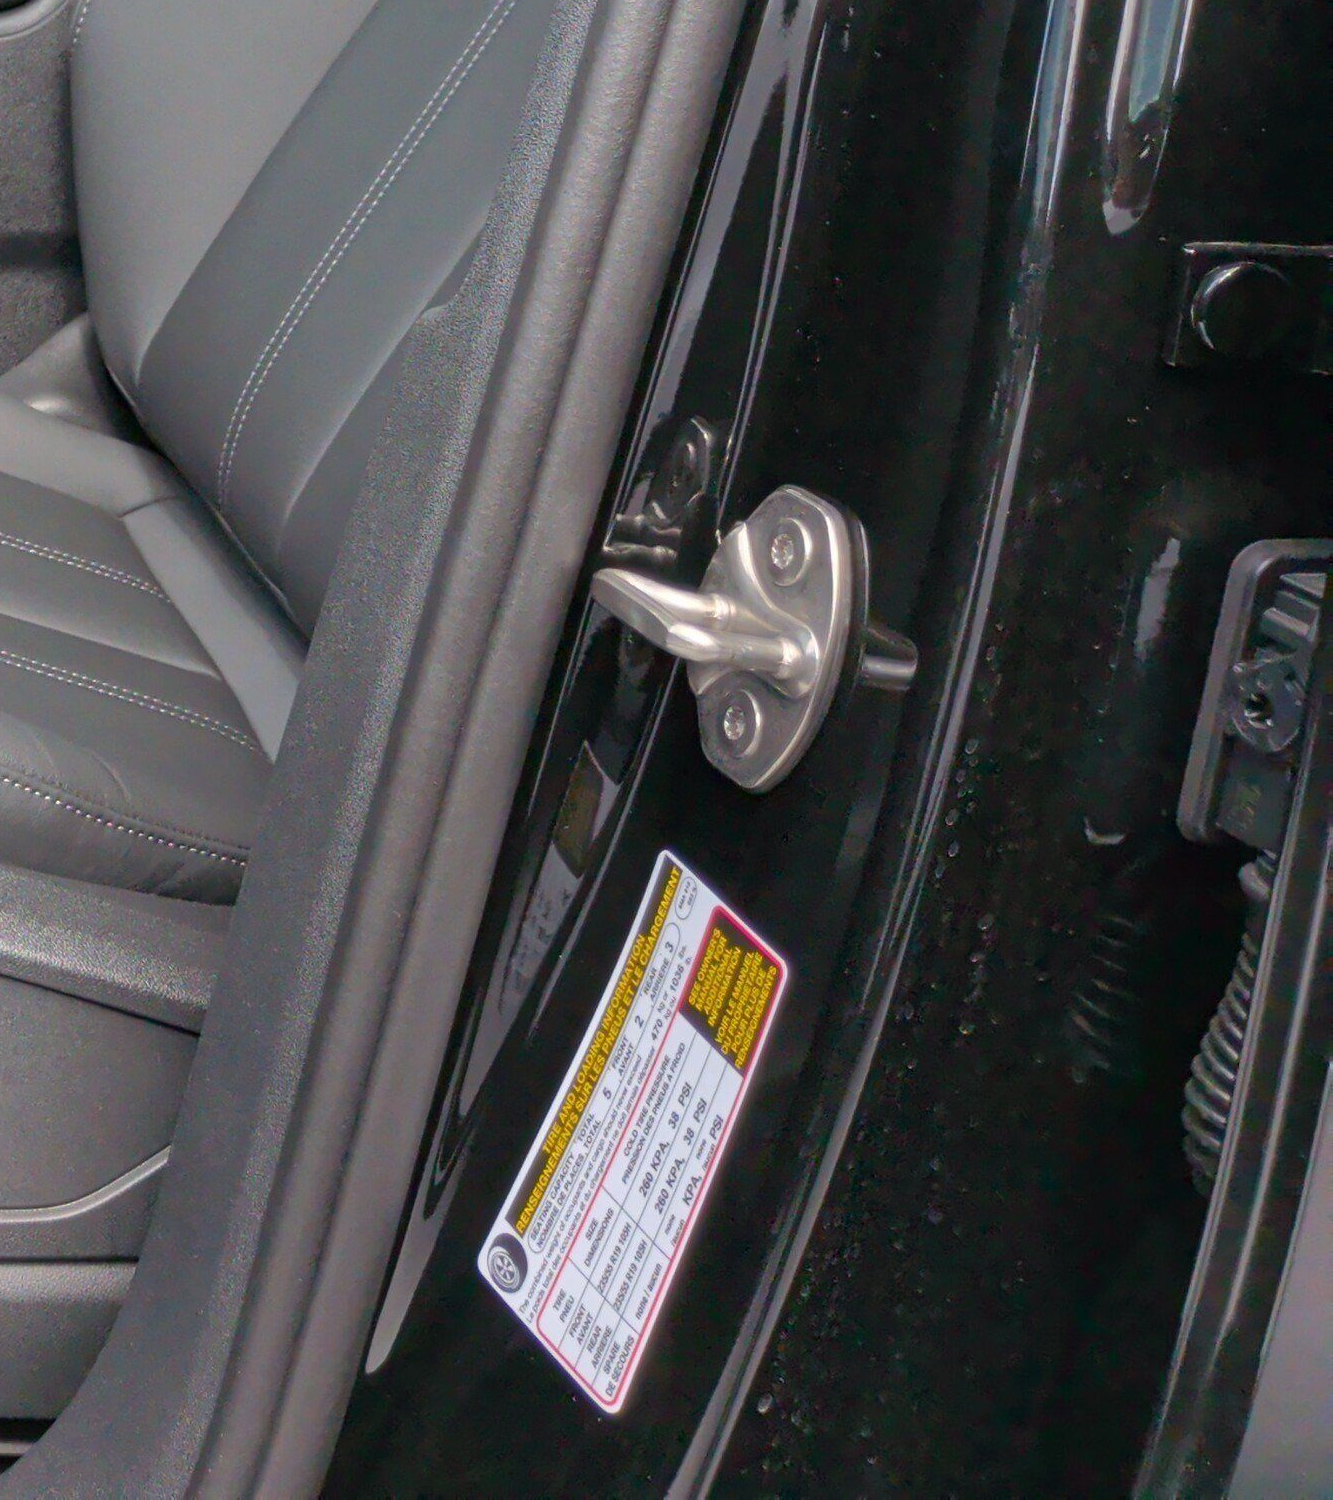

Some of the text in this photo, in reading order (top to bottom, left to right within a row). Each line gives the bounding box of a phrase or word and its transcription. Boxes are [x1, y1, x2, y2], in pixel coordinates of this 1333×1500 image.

[663, 939, 674, 954] 3
[642, 966, 657, 995] REAR
[669, 962, 685, 993] 1036
[687, 979, 701, 1006] SEE
[694, 934, 727, 1011] MANUAL FOR
[702, 945, 732, 1016] ADDITIONAL
[706, 945, 741, 1027] INFORMATION
[714, 948, 754, 1045] VOIR LE MANUEL
[730, 966, 766, 1054] POUR PLUS DE
[733, 963, 777, 1070] RENSEIGNEMENTS
[633, 1013, 644, 1028] 2
[649, 1016, 663, 1042] 470
[514, 865, 680, 1234] RENSEIGNEMENTS SUR LES PNEUS ET LE CHARGEMENT
[541, 932, 646, 1155] TIRE AND LOADING INFORMATION
[610, 1034, 629, 1070] FRONT
[616, 1041, 635, 1077] AVANT
[720, 1034, 732, 1055] DU
[601, 1085, 613, 1101] 5
[620, 1134, 646, 1185] PRESSION
[642, 1113, 655, 1137] DES
[651, 1080, 669, 1116] PNEUS
[668, 1040, 686, 1074] FROID
[622, 1053, 671, 1158] COLD TIRE PRESSURE
[577, 1110, 594, 1143] TOTAL
[583, 1116, 601, 1149] TOTAL
[638, 1080, 692, 1198] 260 KPA, 38 PSI
[708, 1113, 724, 1141] PSI
[525, 1256, 548, 1300] combined
[545, 1229, 563, 1260] weight
[562, 1176, 587, 1224] occupants
[590, 1136, 606, 1164] cargo
[601, 1107, 618, 1139] should
[624, 1053, 642, 1086] exceed
[653, 1096, 707, 1216] 260 KPA, 38 PSI
[529, 1151, 575, 1242] SEATING CAPACITY
[536, 1203, 560, 1249] NOMBRE
[562, 1151, 585, 1191] PLACES
[583, 1206, 614, 1267] DIMENSIONS
[584, 1215, 599, 1242] SIZE
[596, 1220, 632, 1294] 235/55 R19 105H
[612, 1238, 648, 1312] 235/55 R19 105H
[552, 1287, 566, 1313] TIRE
[559, 1293, 575, 1324] PNEU
[635, 1295, 648, 1321] none
[646, 1261, 662, 1293] aucun
[568, 1301, 587, 1339] FRONT
[575, 1310, 594, 1346] AVANT
[586, 1323, 602, 1355] REAR
[602, 1339, 620, 1376] SPARE
[611, 1332, 635, 1384] SECOURS
